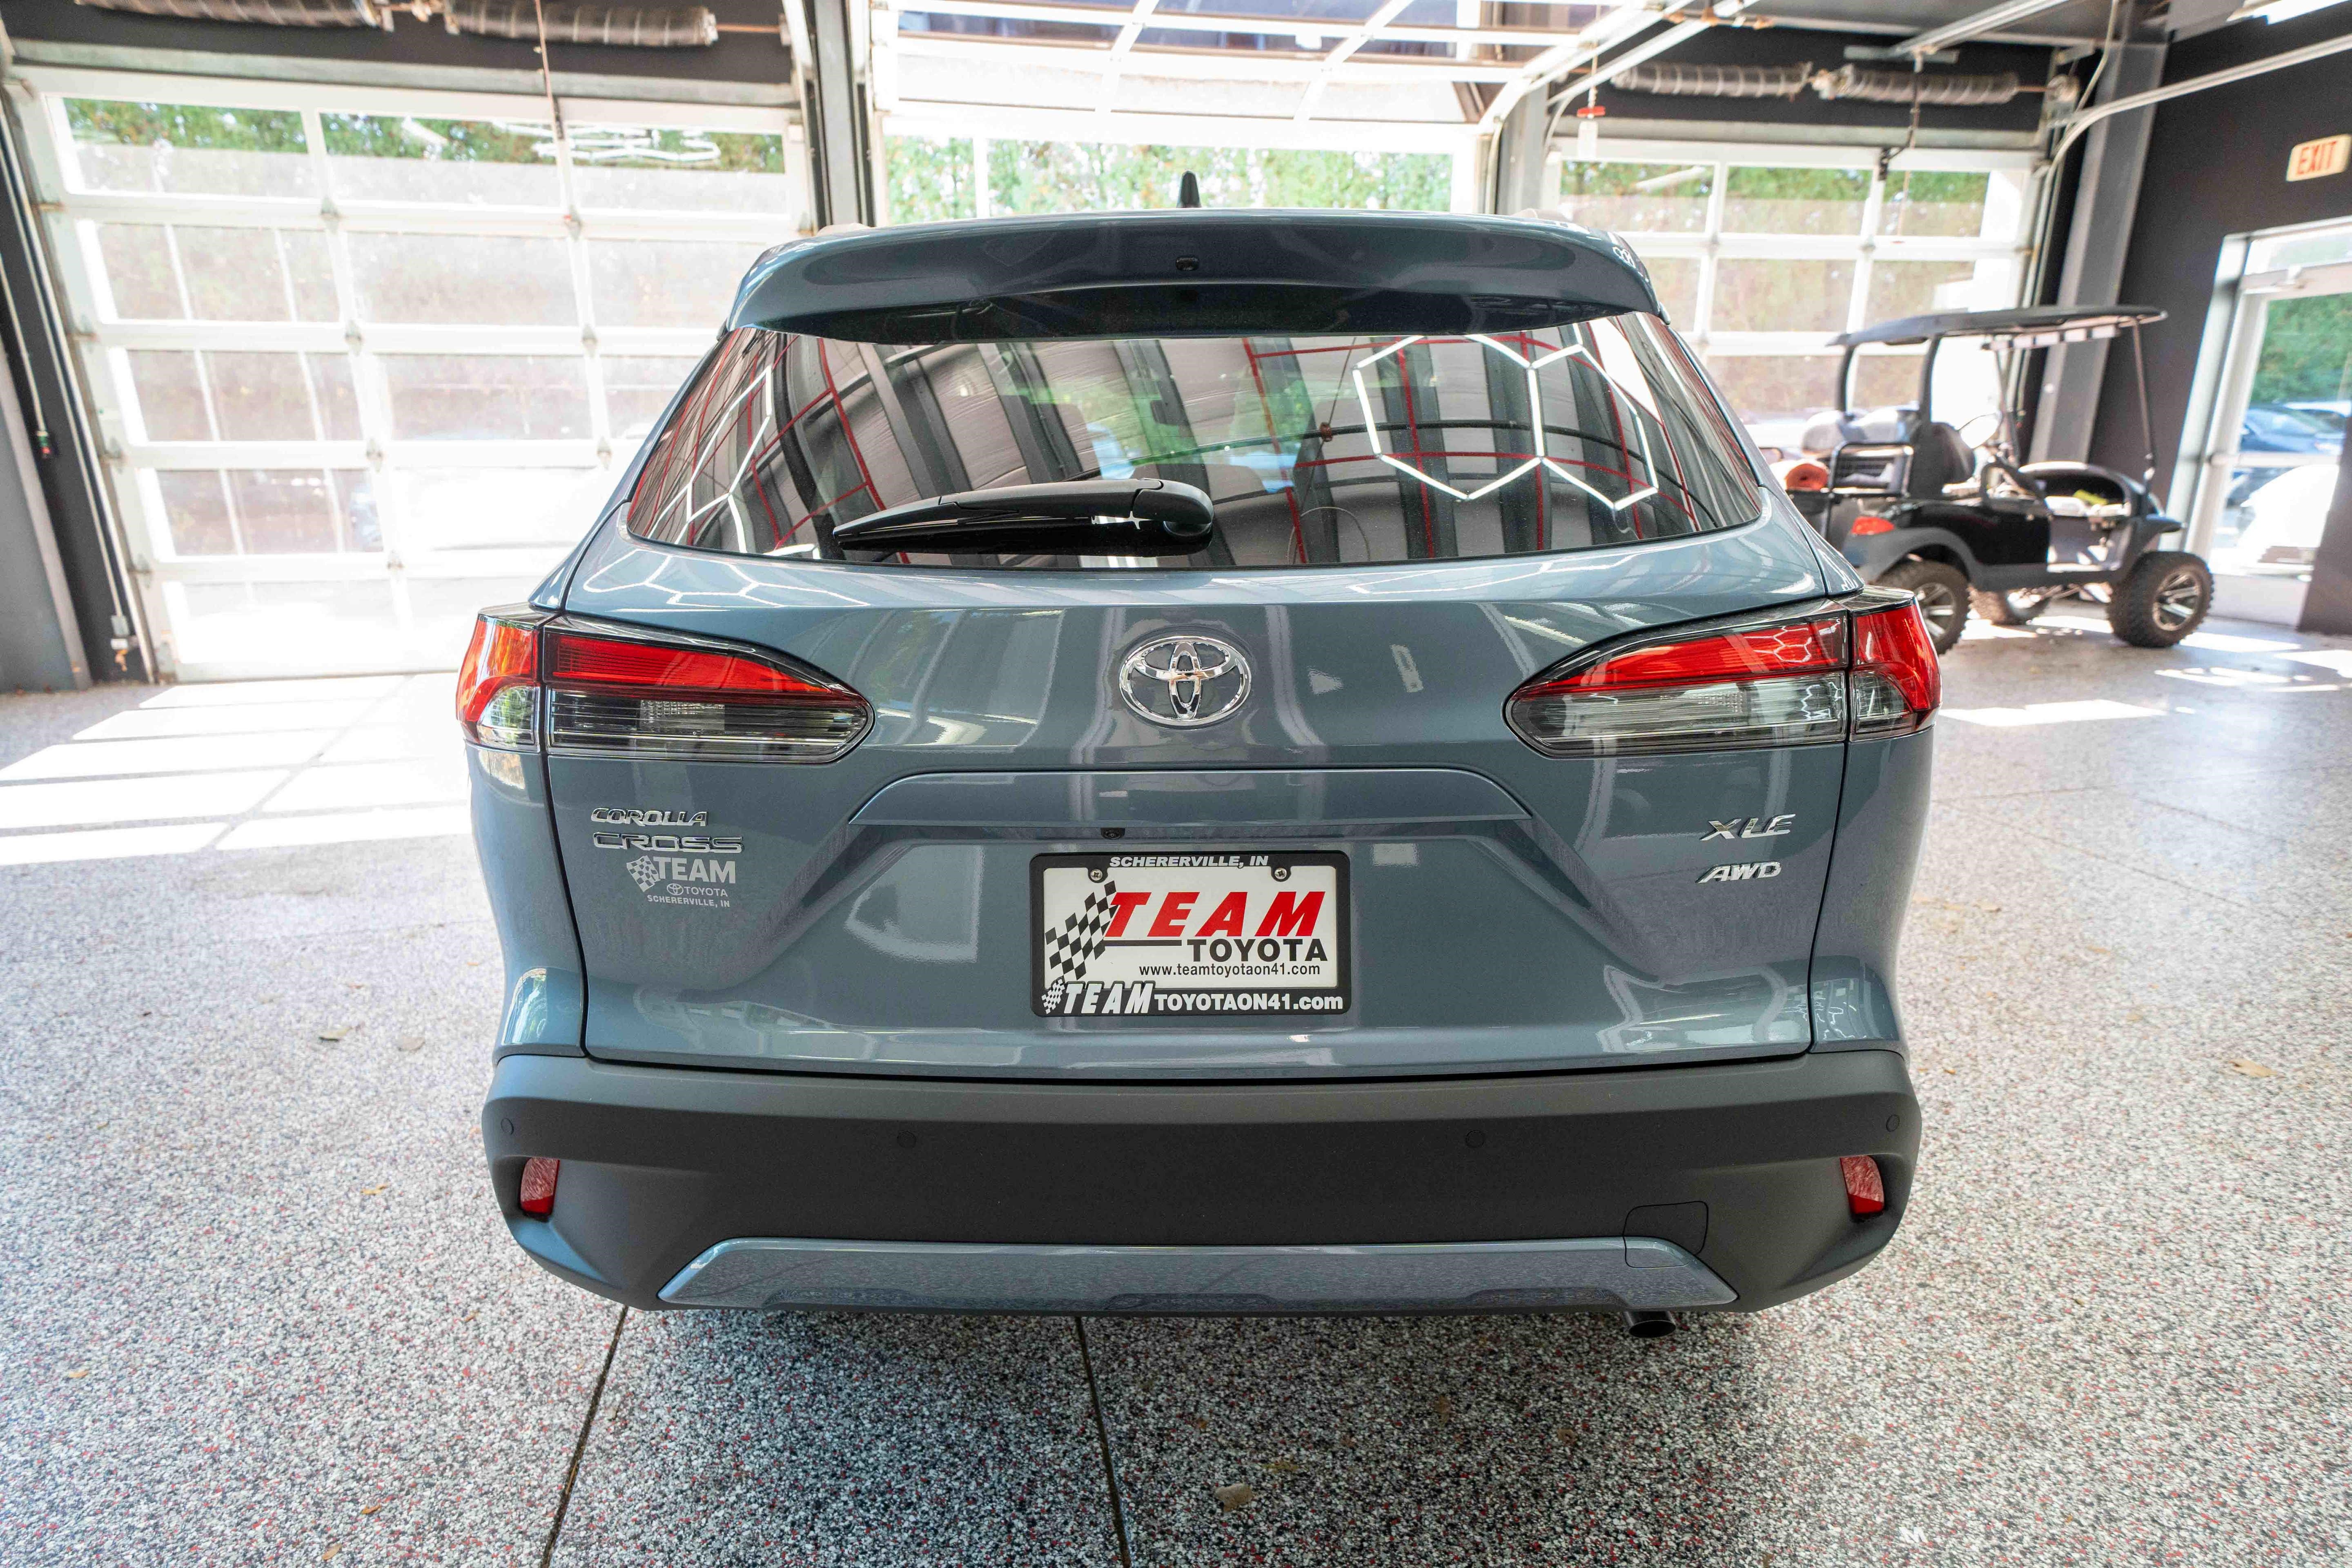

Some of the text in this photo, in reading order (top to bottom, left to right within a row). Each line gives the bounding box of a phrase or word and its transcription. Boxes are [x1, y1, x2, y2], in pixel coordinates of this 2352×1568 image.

[2296, 140, 2338, 176] EXIT
[591, 807, 709, 826] COROLLA
[1699, 814, 1796, 841] XLE
[593, 832, 745, 853] CROSS
[653, 856, 735, 884] TEAM
[1109, 855, 1268, 868] SCHERERVILLE, IN
[1695, 861, 1782, 883] AWD
[647, 895, 730, 908] SCHERERVILLE, IN
[684, 886, 728, 897] TOYOTA
[1105, 891, 1325, 937] TEAM
[1187, 938, 1327, 962] TOYOTA
[1139, 963, 1320, 978] www.teamtoyotaon41.com
[1064, 983, 1343, 1013] TEAM TOYOTAON41.com
